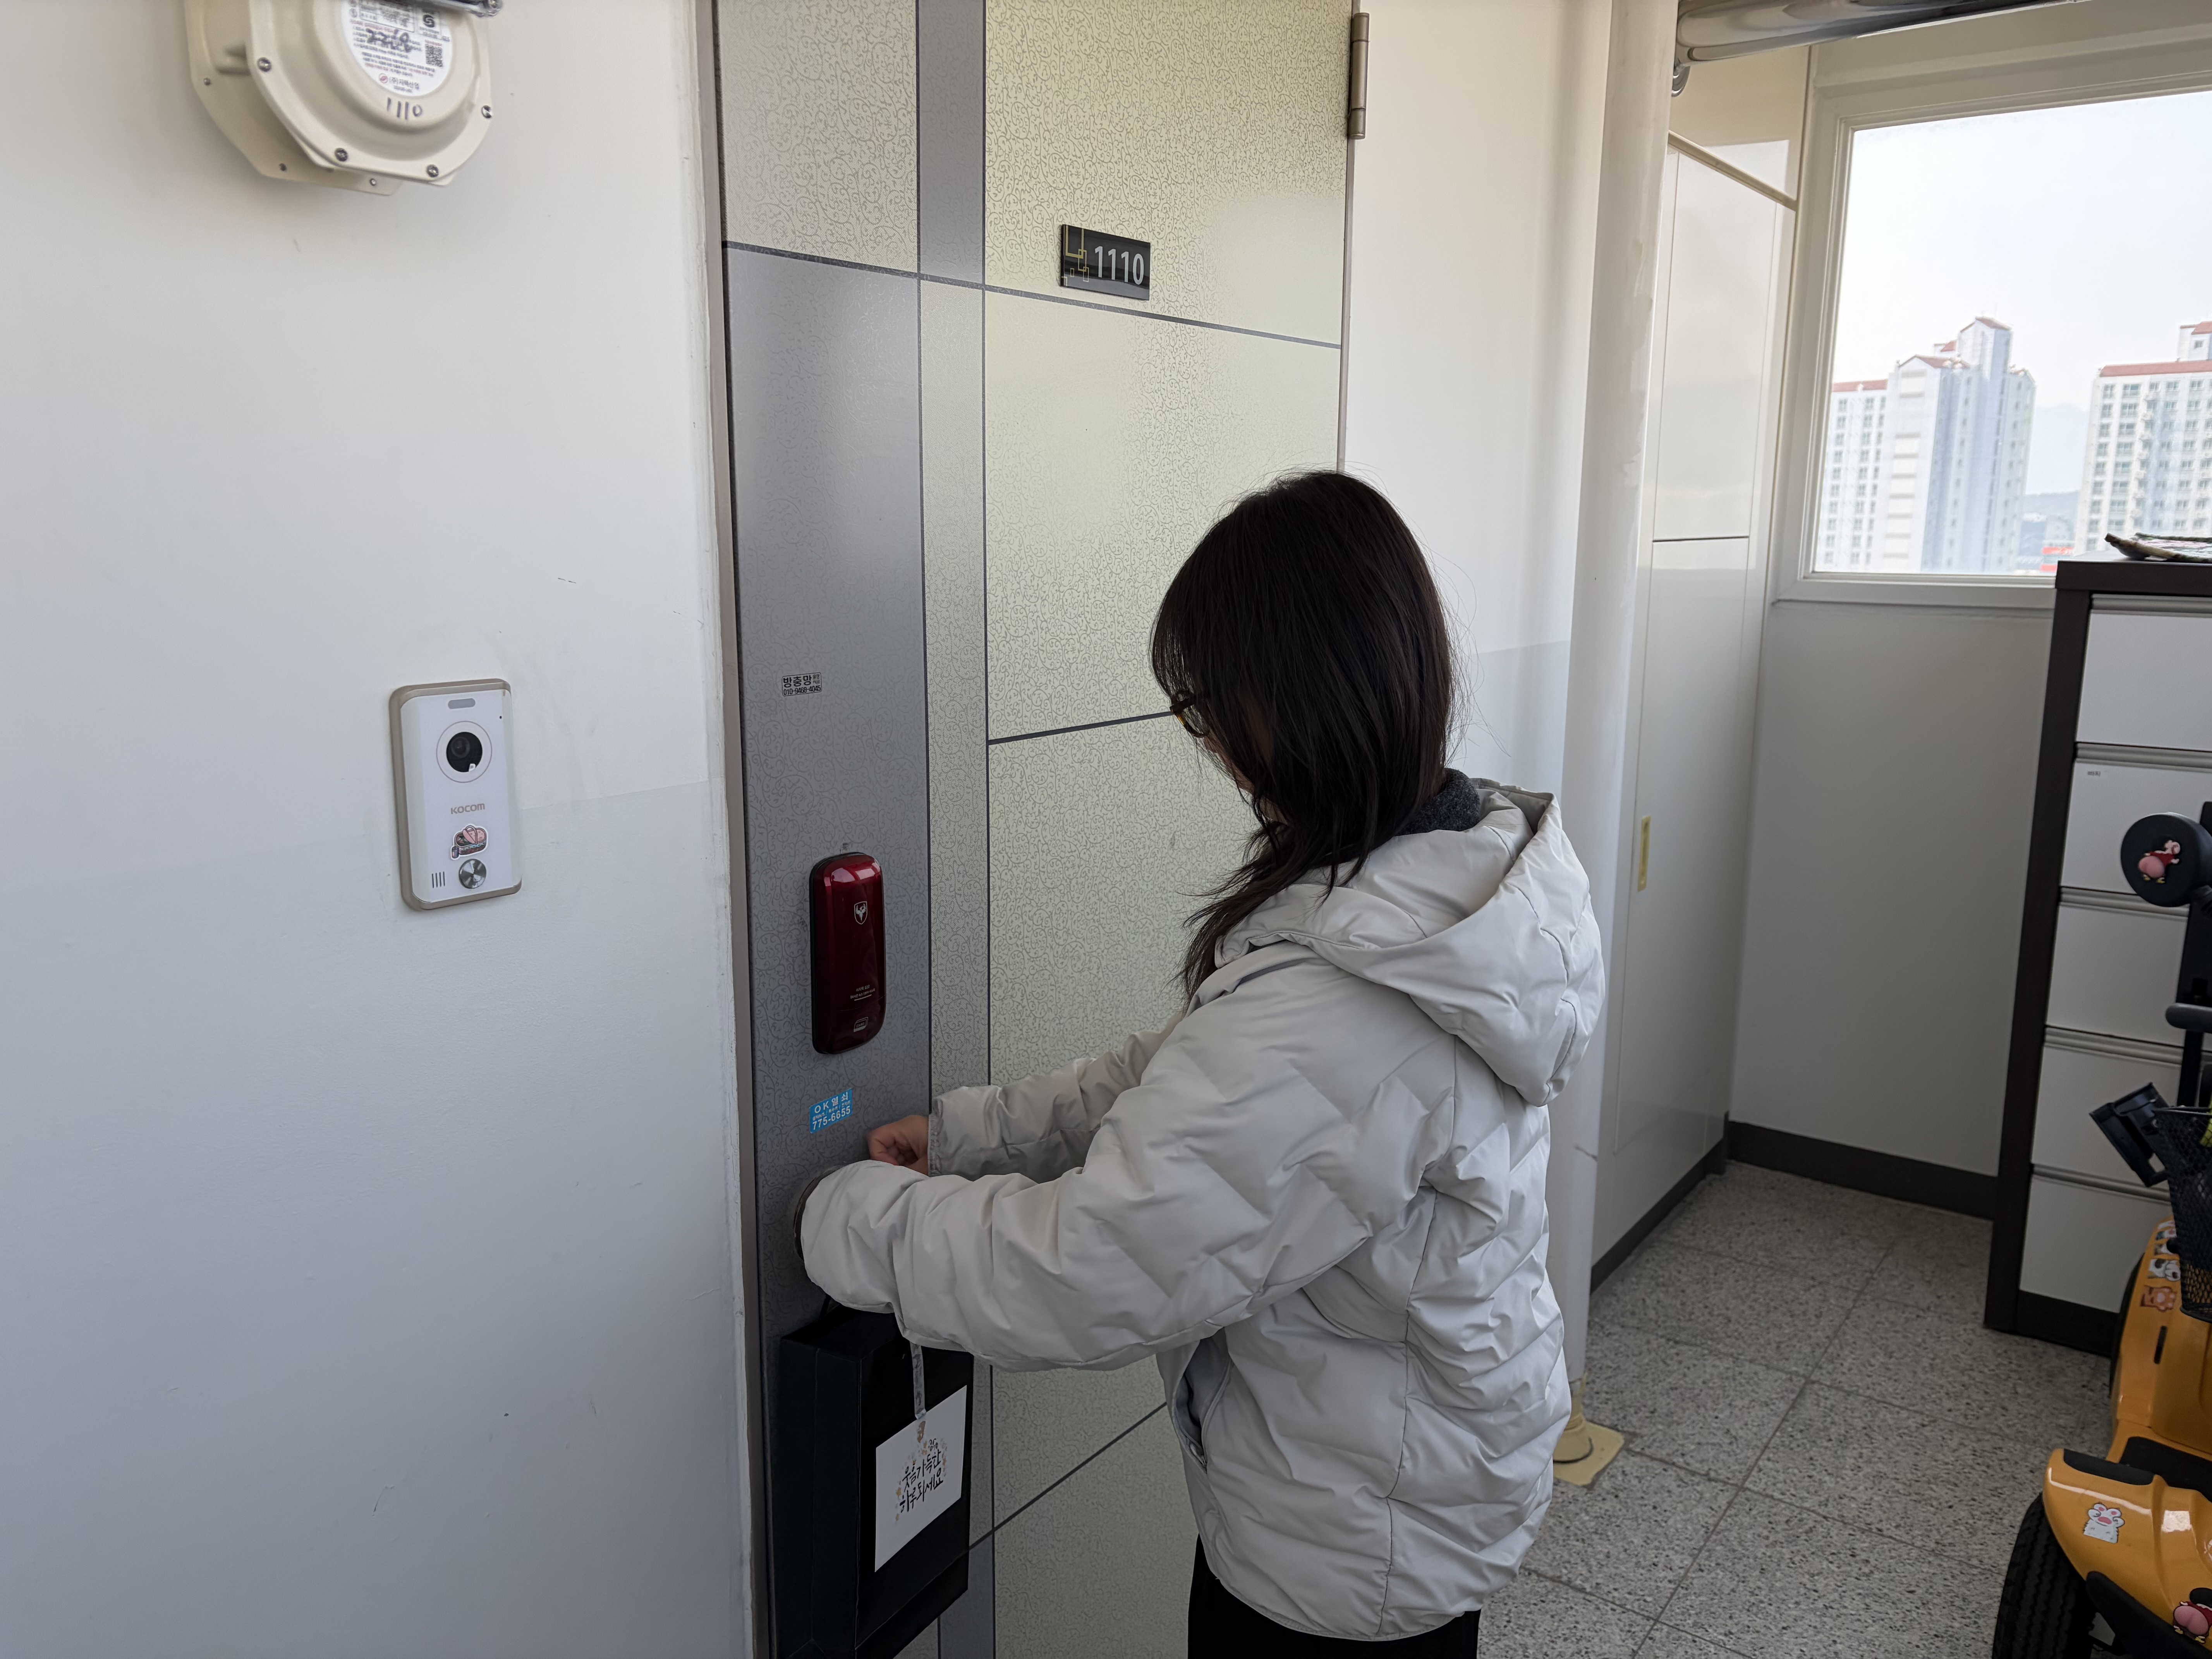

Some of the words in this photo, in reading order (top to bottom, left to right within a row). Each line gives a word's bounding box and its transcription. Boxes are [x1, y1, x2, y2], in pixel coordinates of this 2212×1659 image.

[387, 97, 423, 120] 1110
[1095, 246, 1144, 285] 1110
[783, 675, 812, 688] 방충망
[451, 803, 485, 814] KOCOM
[812, 1106, 851, 1130] 775-6655
